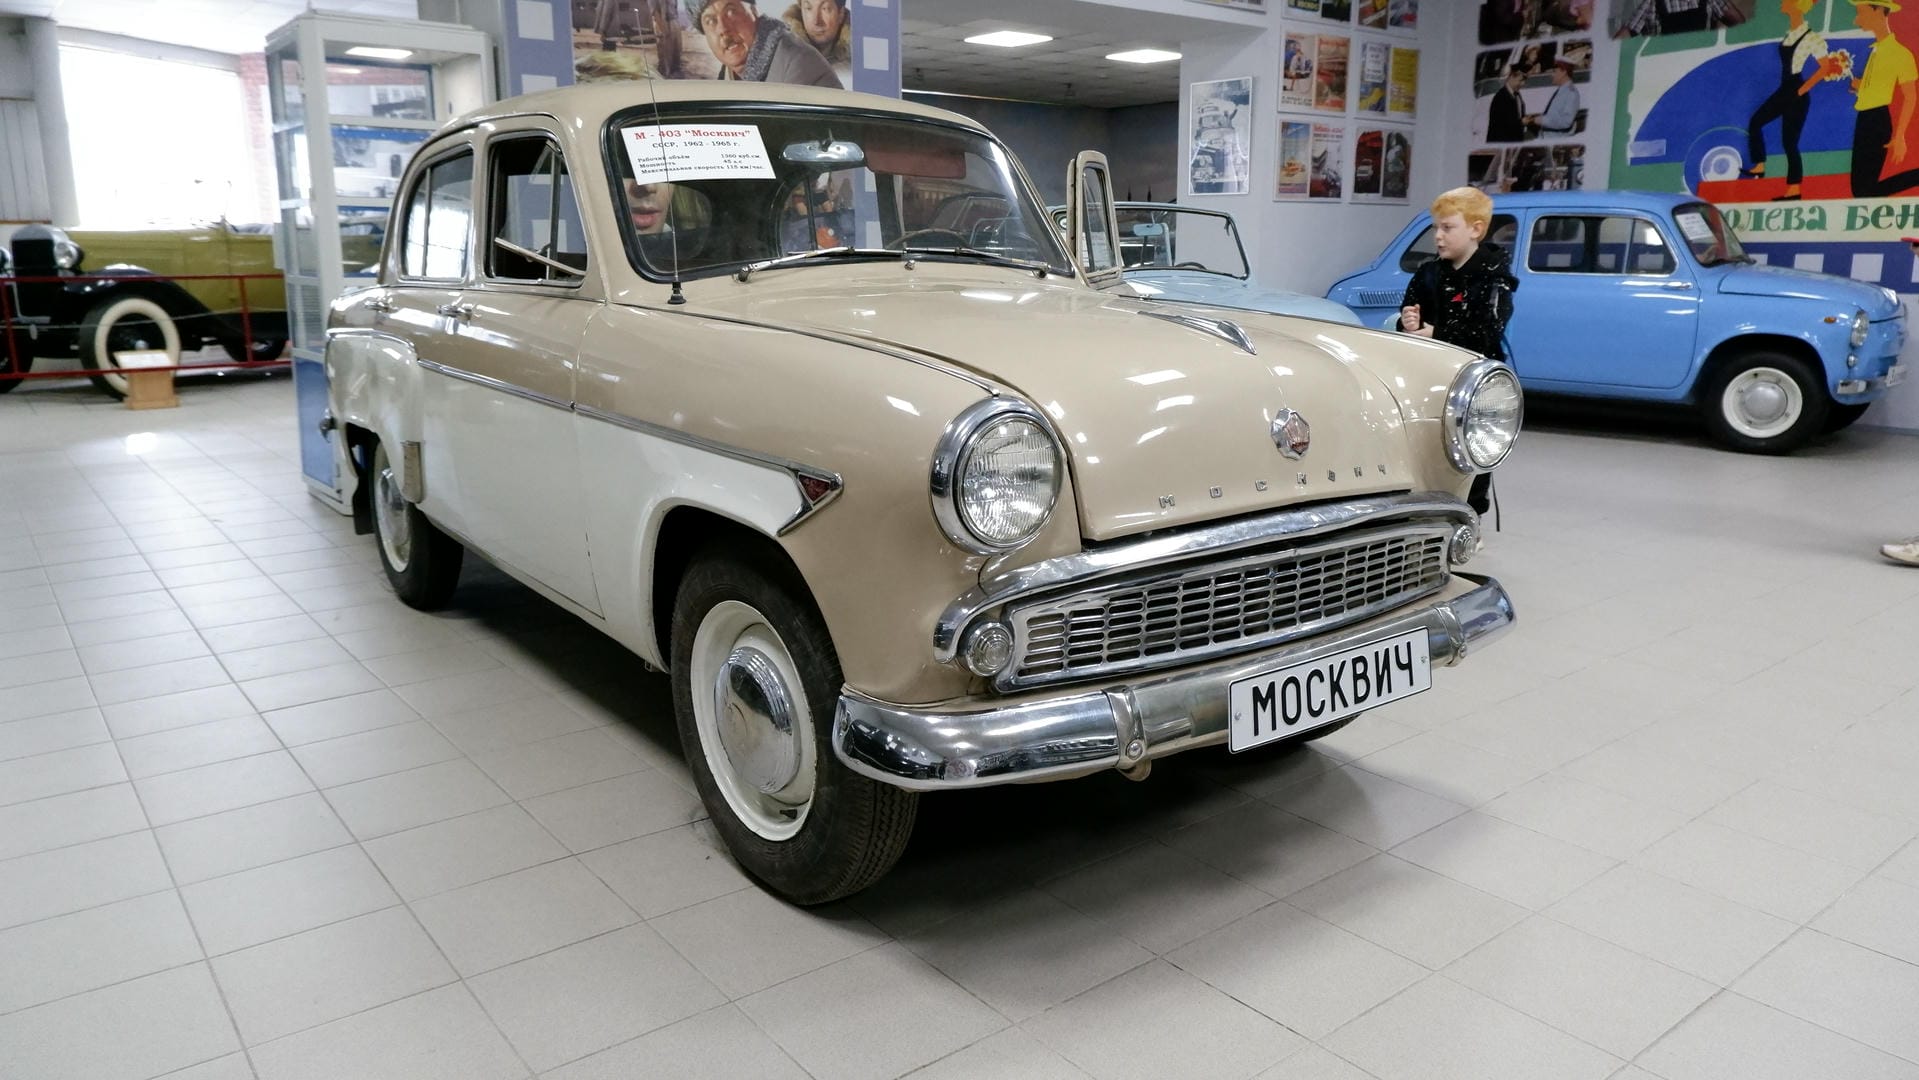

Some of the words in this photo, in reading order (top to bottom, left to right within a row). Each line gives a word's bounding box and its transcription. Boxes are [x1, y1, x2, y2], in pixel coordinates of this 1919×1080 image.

[634, 132, 646, 140] М
[658, 130, 681, 138] 403
[1158, 463, 1387, 509] МОСКВИЧ
[1252, 641, 1414, 737] МОСКВИЧ
